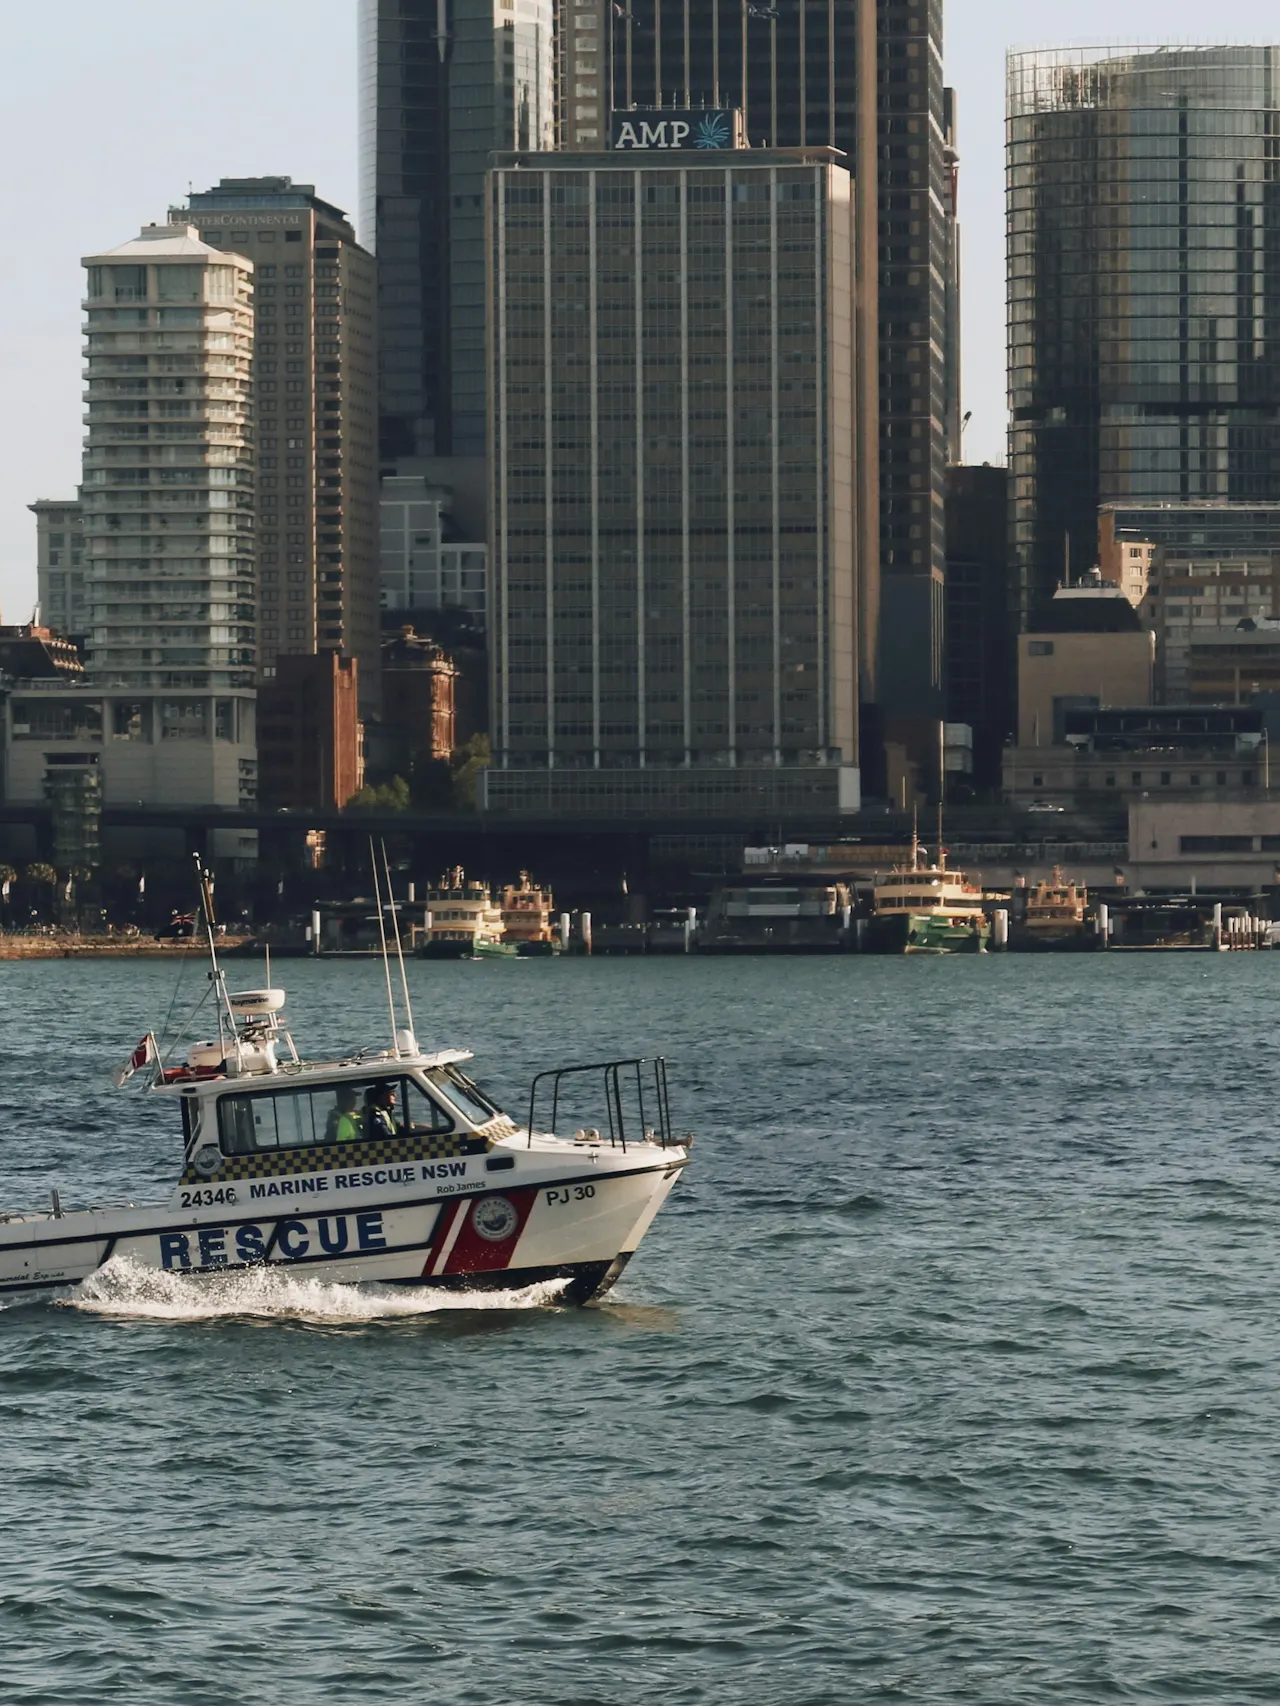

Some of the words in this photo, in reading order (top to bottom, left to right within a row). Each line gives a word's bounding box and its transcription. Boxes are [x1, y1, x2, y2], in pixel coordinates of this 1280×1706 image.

[615, 121, 690, 149] AMP
[250, 1176, 329, 1199] MARINE
[334, 1167, 416, 1189] RESCUE
[422, 1162, 467, 1180] NSW
[437, 1184, 455, 1194] Rob
[456, 1180, 486, 1192] James
[181, 1187, 237, 1208] 24346
[546, 1188, 570, 1206] PJ
[573, 1185, 596, 1201] 30
[159, 1212, 388, 1269] RESCUE
